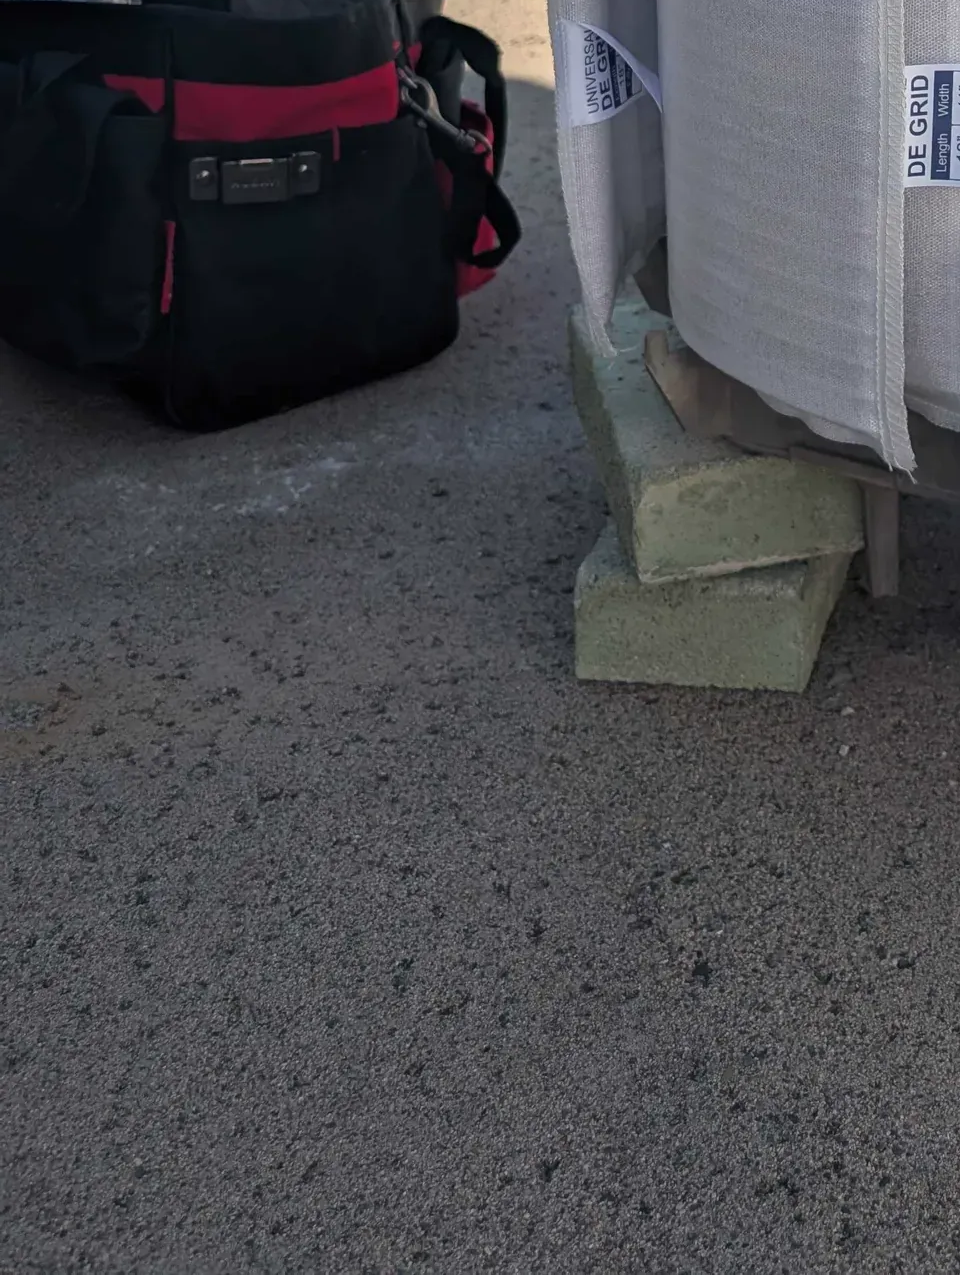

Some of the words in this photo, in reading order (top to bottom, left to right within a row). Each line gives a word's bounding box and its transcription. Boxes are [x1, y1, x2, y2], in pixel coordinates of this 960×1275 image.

[599, 78, 613, 111] DE
[909, 74, 929, 137] GRID
[938, 83, 951, 117] Width
[907, 144, 927, 177] DE
[935, 133, 951, 173] Length
